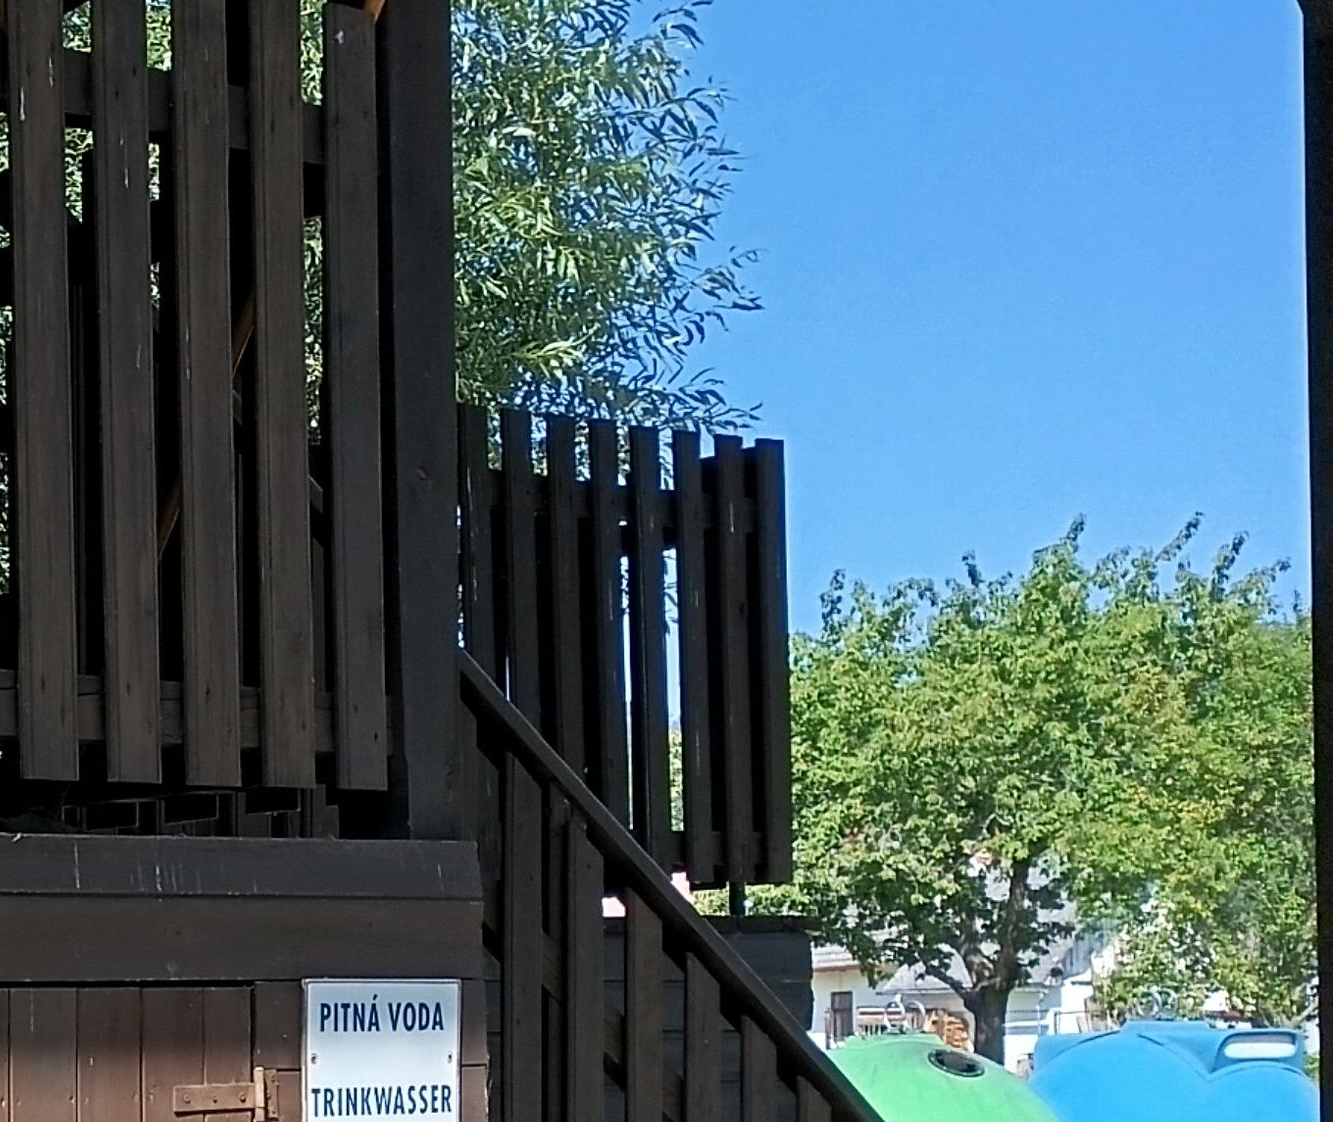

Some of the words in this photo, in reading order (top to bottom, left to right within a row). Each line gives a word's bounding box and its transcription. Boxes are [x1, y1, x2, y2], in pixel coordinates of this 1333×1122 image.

[320, 994, 380, 1032] PITNÁ
[388, 1002, 444, 1032] VODA
[311, 1085, 452, 1117] TRINKWASSER
